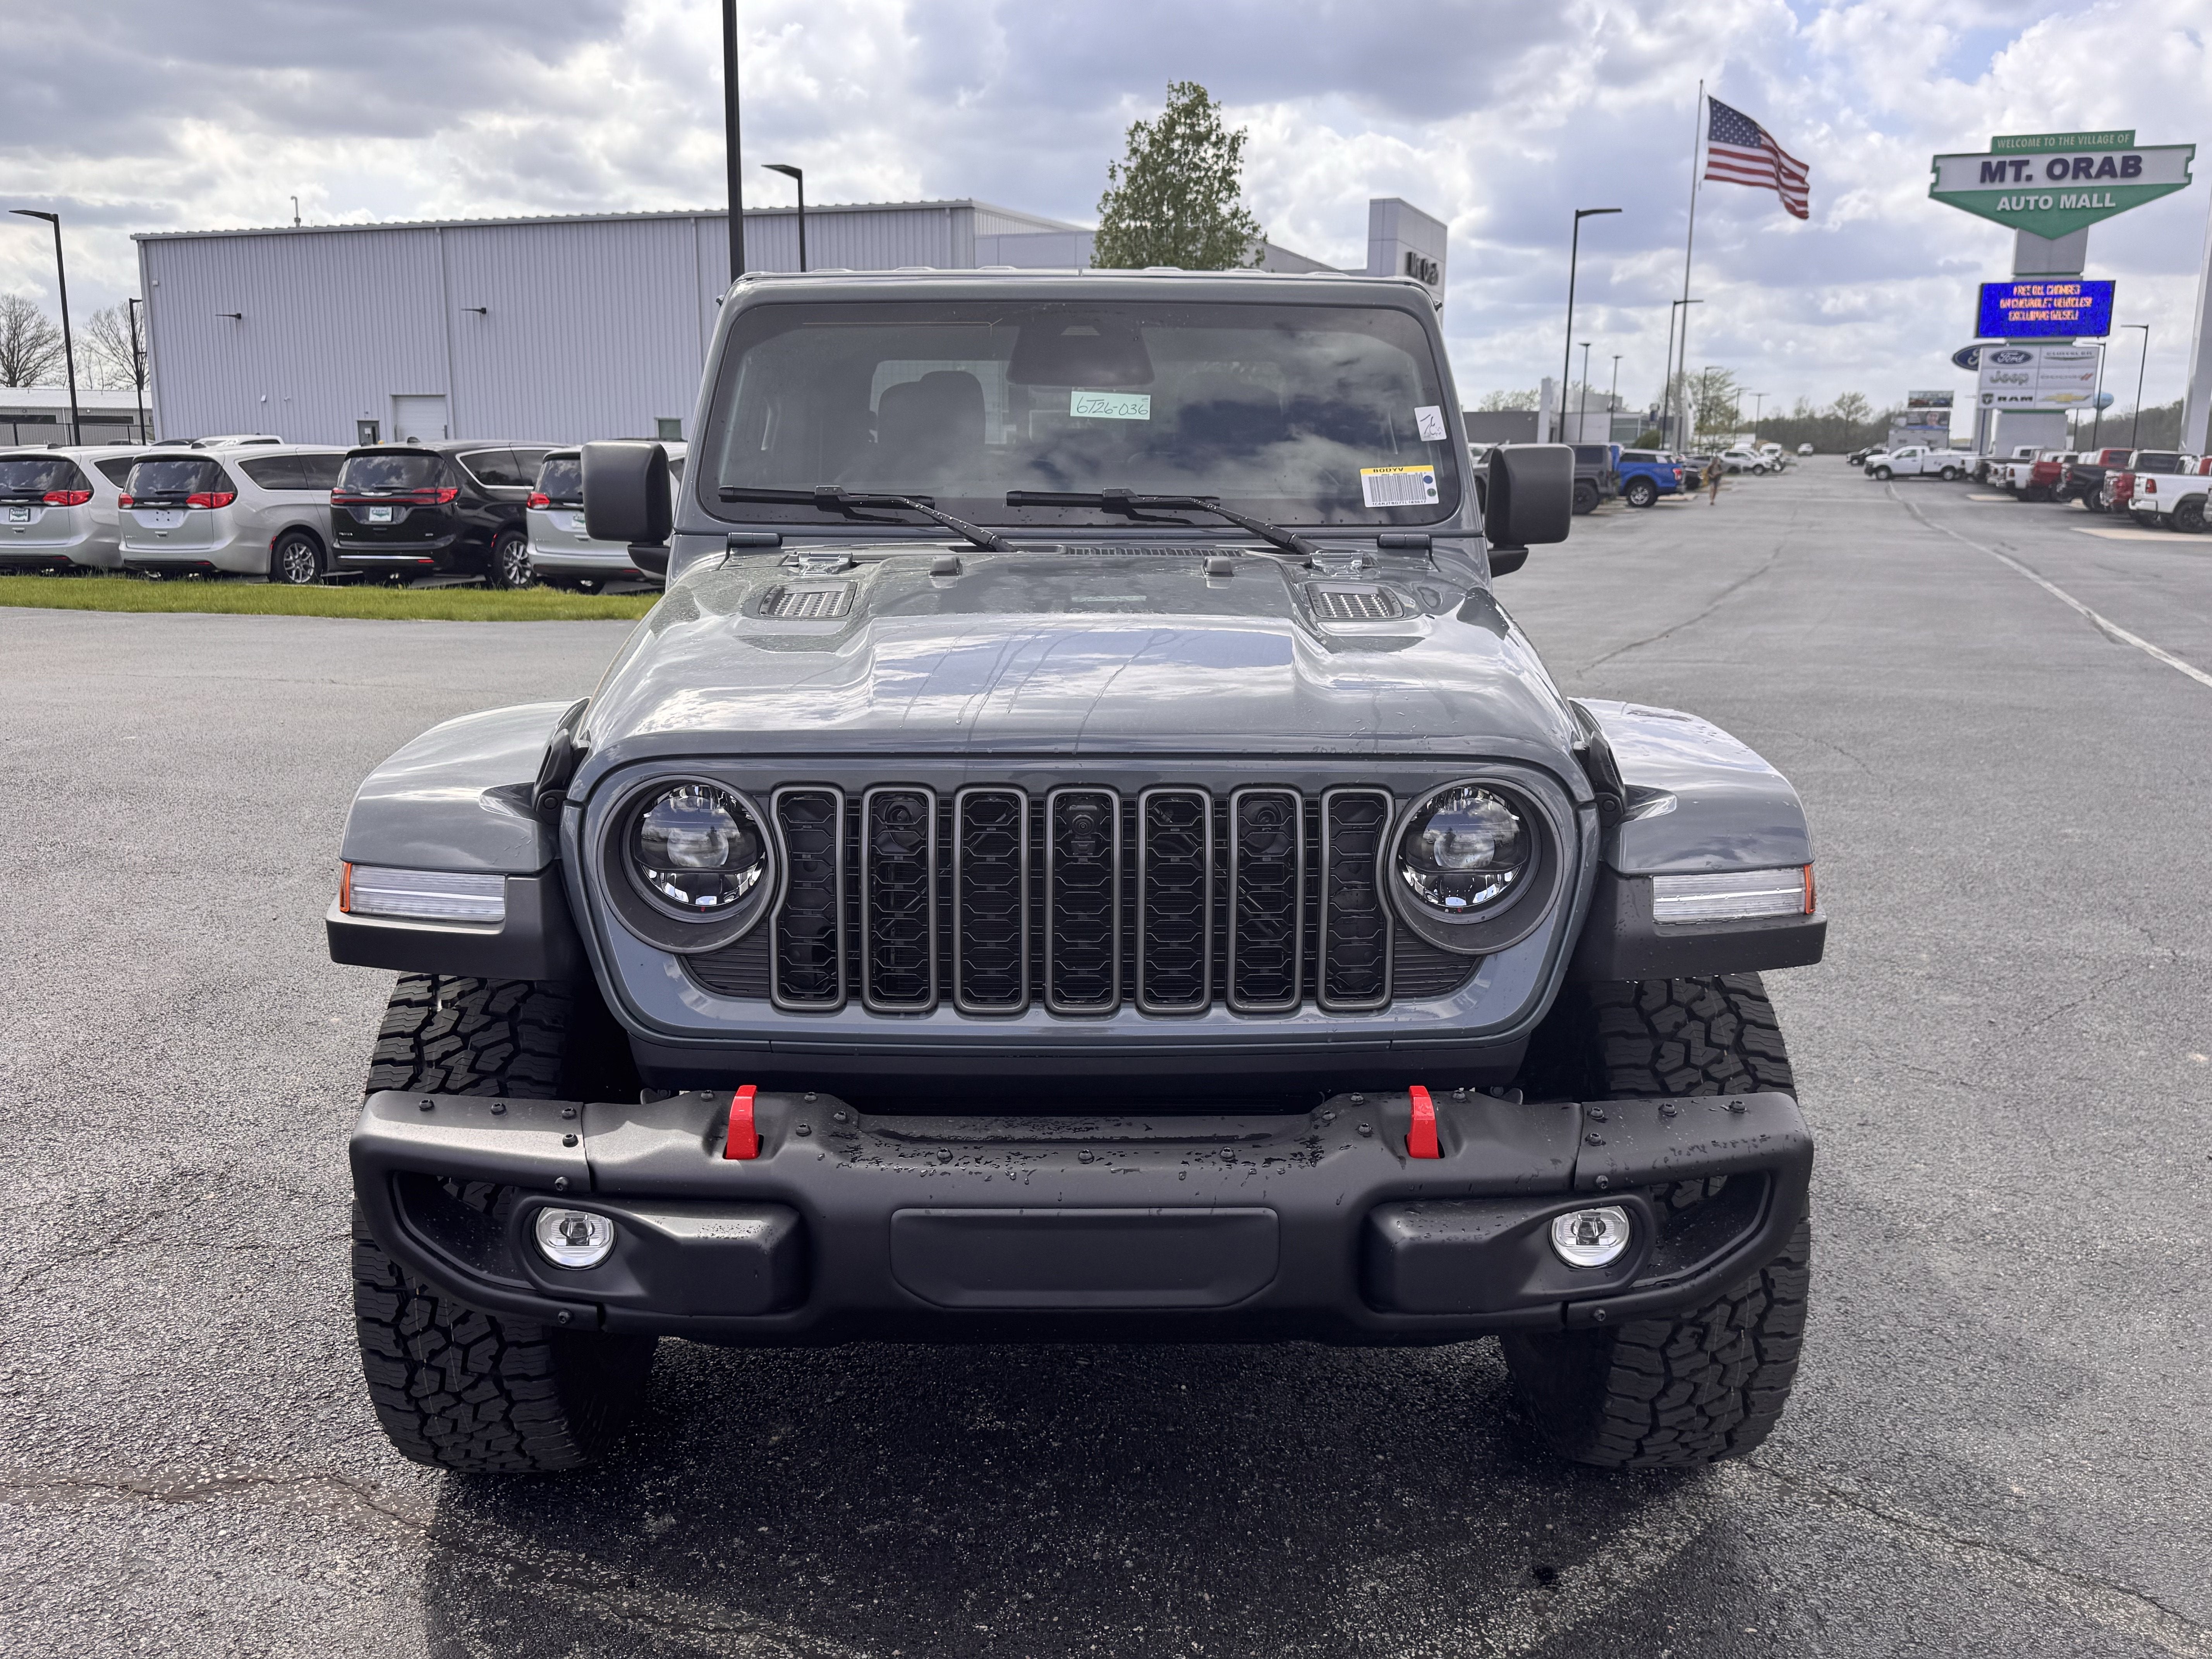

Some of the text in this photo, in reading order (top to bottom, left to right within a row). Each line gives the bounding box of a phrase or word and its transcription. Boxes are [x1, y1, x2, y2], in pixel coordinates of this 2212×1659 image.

[1997, 134, 2130, 148] WELCOME TO THE VILLAGE OF
[1980, 155, 2142, 183] MT. ORAB
[1996, 193, 2116, 211] AUTO MALL
[1997, 351, 2024, 363] Ford
[1989, 370, 2029, 386] Jeep
